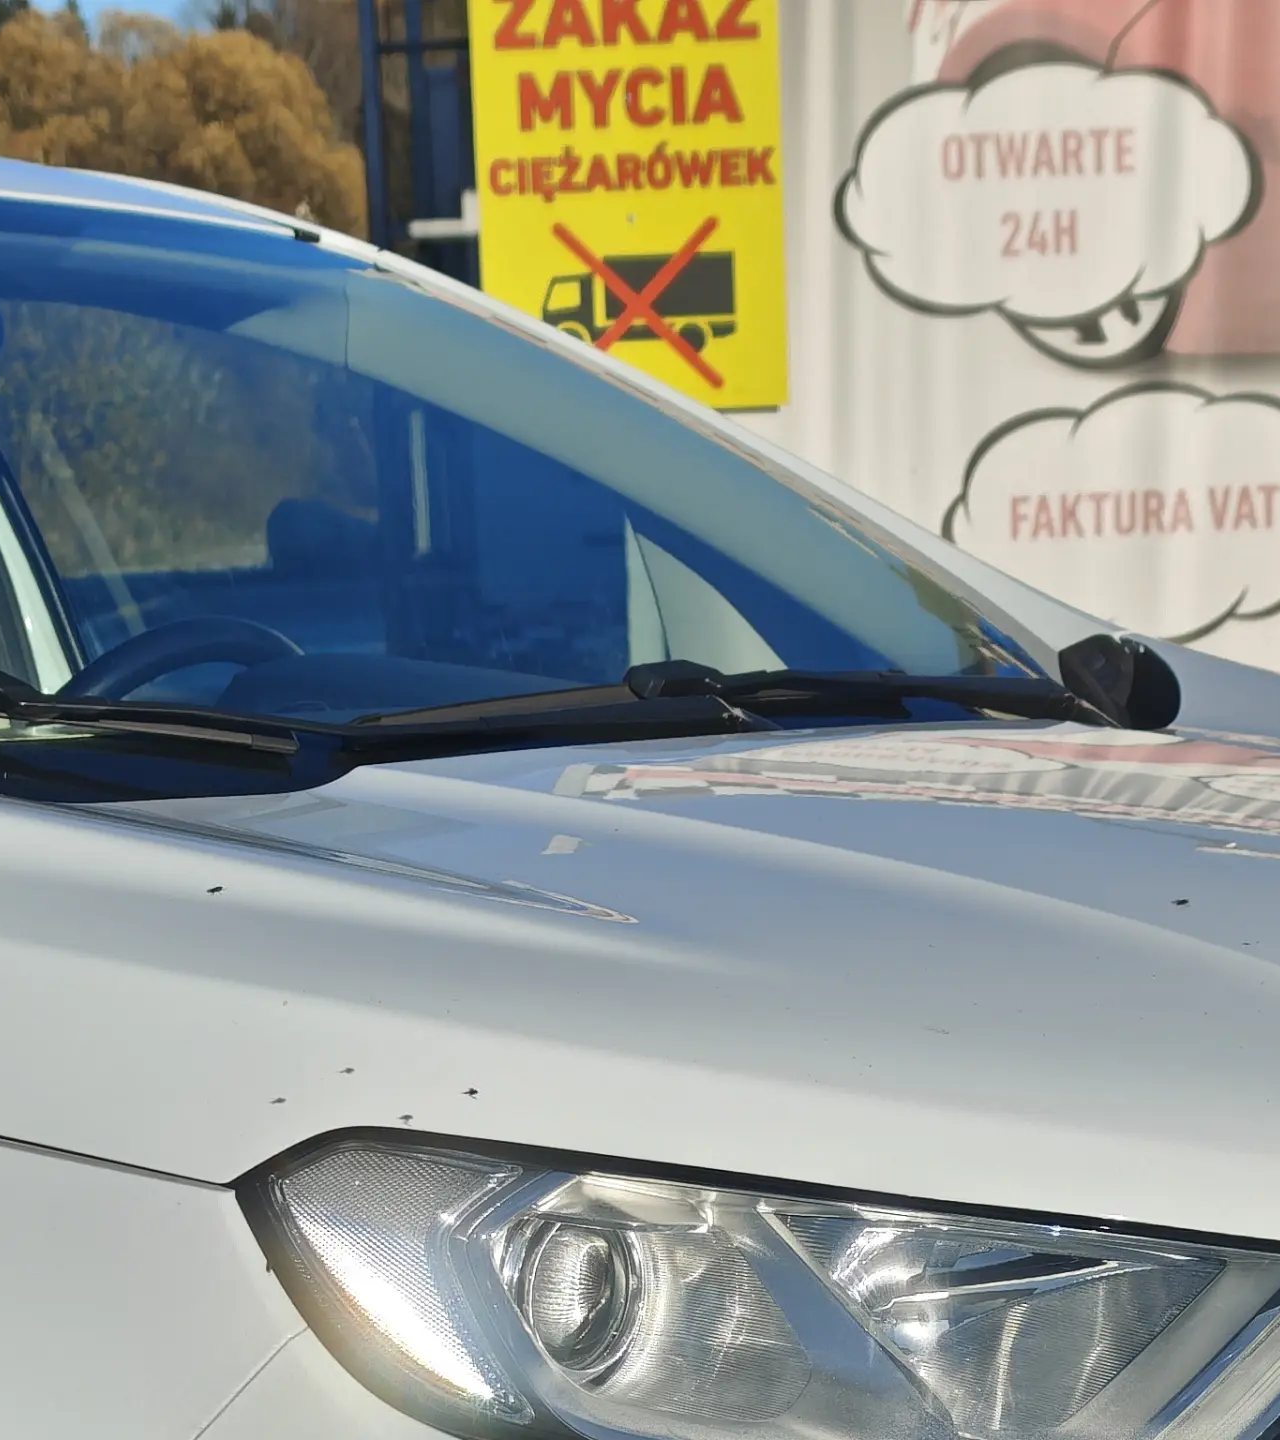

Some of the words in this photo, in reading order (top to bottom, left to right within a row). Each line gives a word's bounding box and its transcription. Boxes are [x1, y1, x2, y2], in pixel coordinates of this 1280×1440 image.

[492, 0, 761, 50] ZAKAZ
[518, 64, 745, 132] MYCIA
[489, 140, 776, 203] CIĘŻARÓWEK
[940, 128, 1136, 182] OTWARTE
[1000, 208, 1080, 258] 24H
[1009, 487, 1194, 542] FAKTURA
